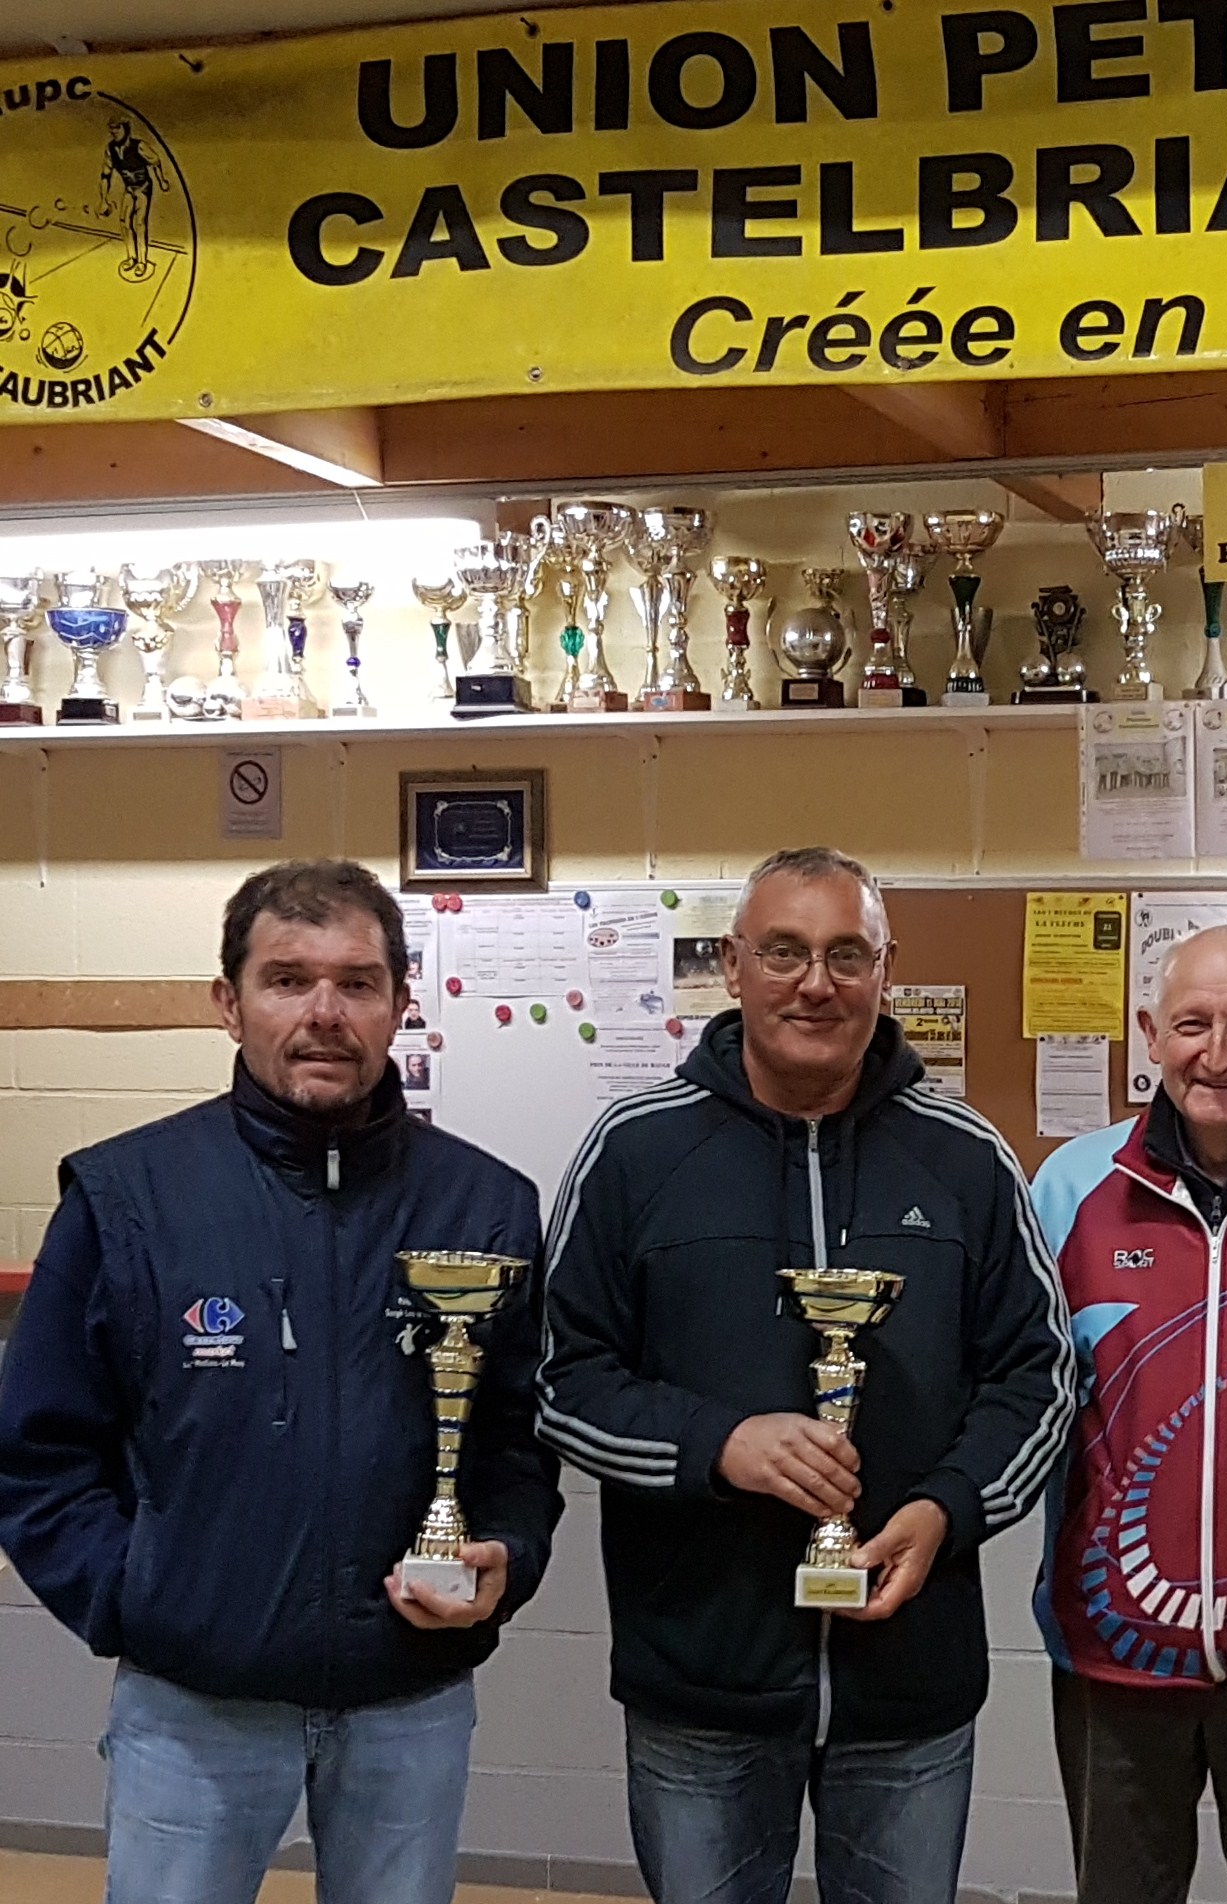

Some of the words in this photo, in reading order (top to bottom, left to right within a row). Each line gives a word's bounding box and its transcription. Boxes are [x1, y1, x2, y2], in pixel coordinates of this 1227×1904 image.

[357, 20, 878, 151] UNION
[0, 327, 169, 409] AUBRIANT
[670, 287, 1015, 375] Créée
[1059, 295, 1207, 359] en
